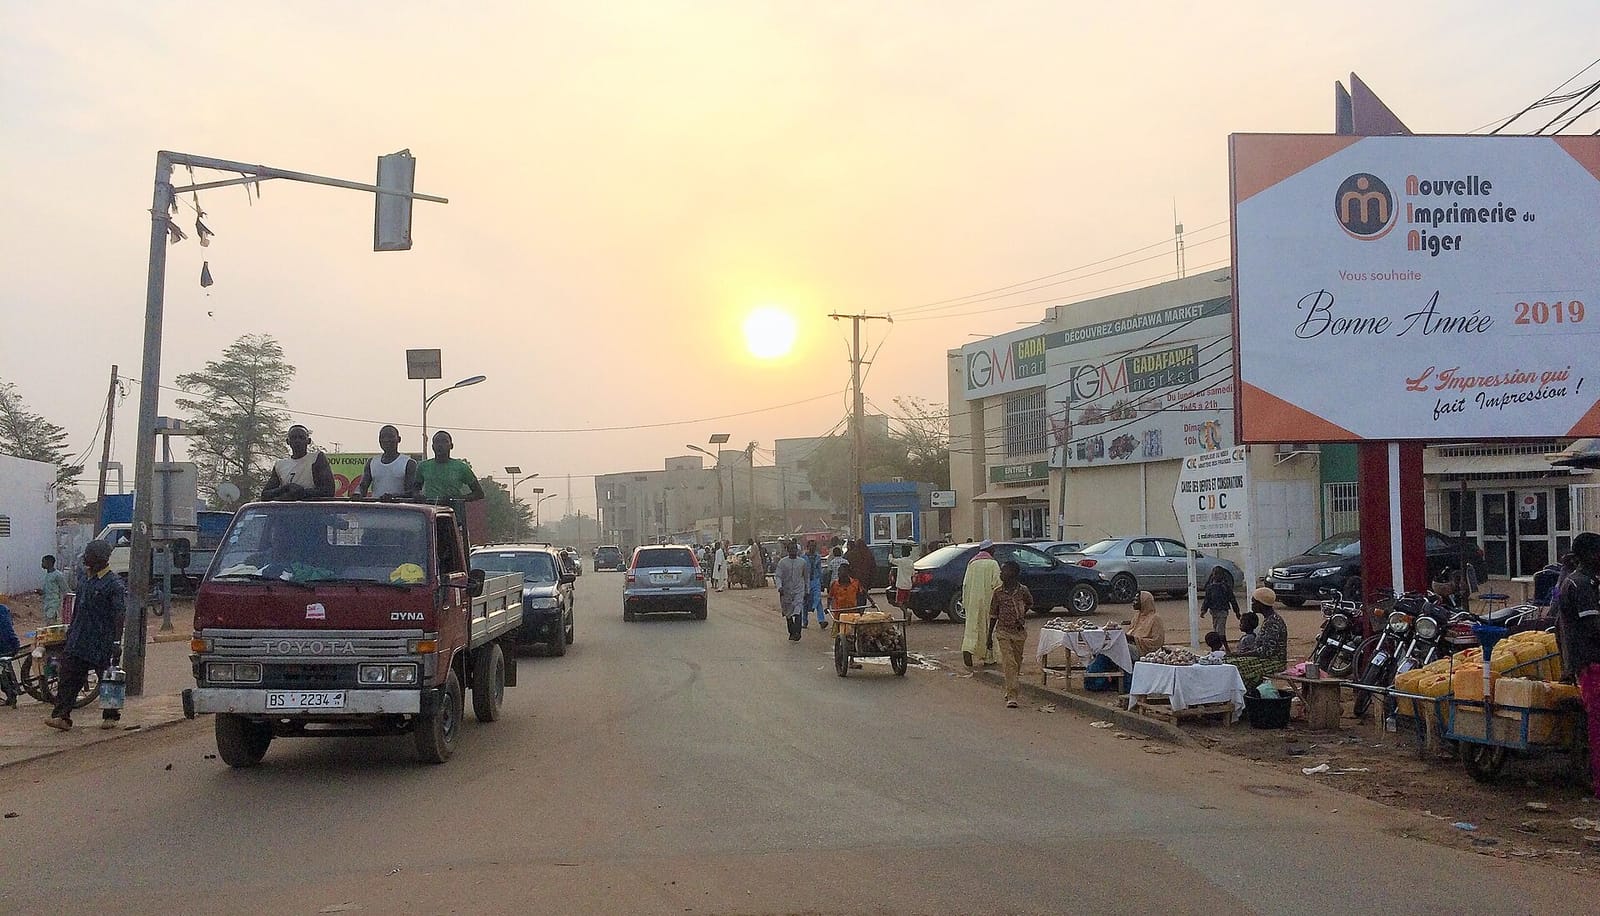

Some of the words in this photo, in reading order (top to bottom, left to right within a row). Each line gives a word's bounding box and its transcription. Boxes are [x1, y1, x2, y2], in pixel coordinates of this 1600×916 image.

[1405, 174, 1493, 196] Nouvelle
[1406, 201, 1517, 229] Imprimerie
[1522, 211, 1536, 223] du
[1407, 229, 1462, 257] Niger
[1338, 269, 1368, 281] Vous
[1370, 269, 1422, 281] souhaite
[1114, 314, 1163, 333] GADAFAWA
[1164, 304, 1205, 324] MARKET
[1295, 289, 1392, 339] Bonne
[1396, 289, 1495, 337] Année
[1514, 300, 1586, 325] 2019
[971, 344, 1015, 388] GM
[1133, 346, 1195, 375] GADAFAWA
[1073, 358, 1129, 400] GM
[1133, 367, 1195, 391] market
[1206, 384, 1234, 396] samedi
[1406, 365, 1538, 393] L'Impression
[1540, 366, 1571, 389] qui
[1204, 400, 1218, 409] 21h
[1433, 398, 1466, 421] fait
[1475, 385, 1567, 412] Impression
[1184, 436, 1197, 446] 10h
[390, 612, 425, 621] DYNA
[263, 640, 356, 654] TOYOTA
[269, 694, 286, 706] BS
[300, 693, 330, 706] 2234
